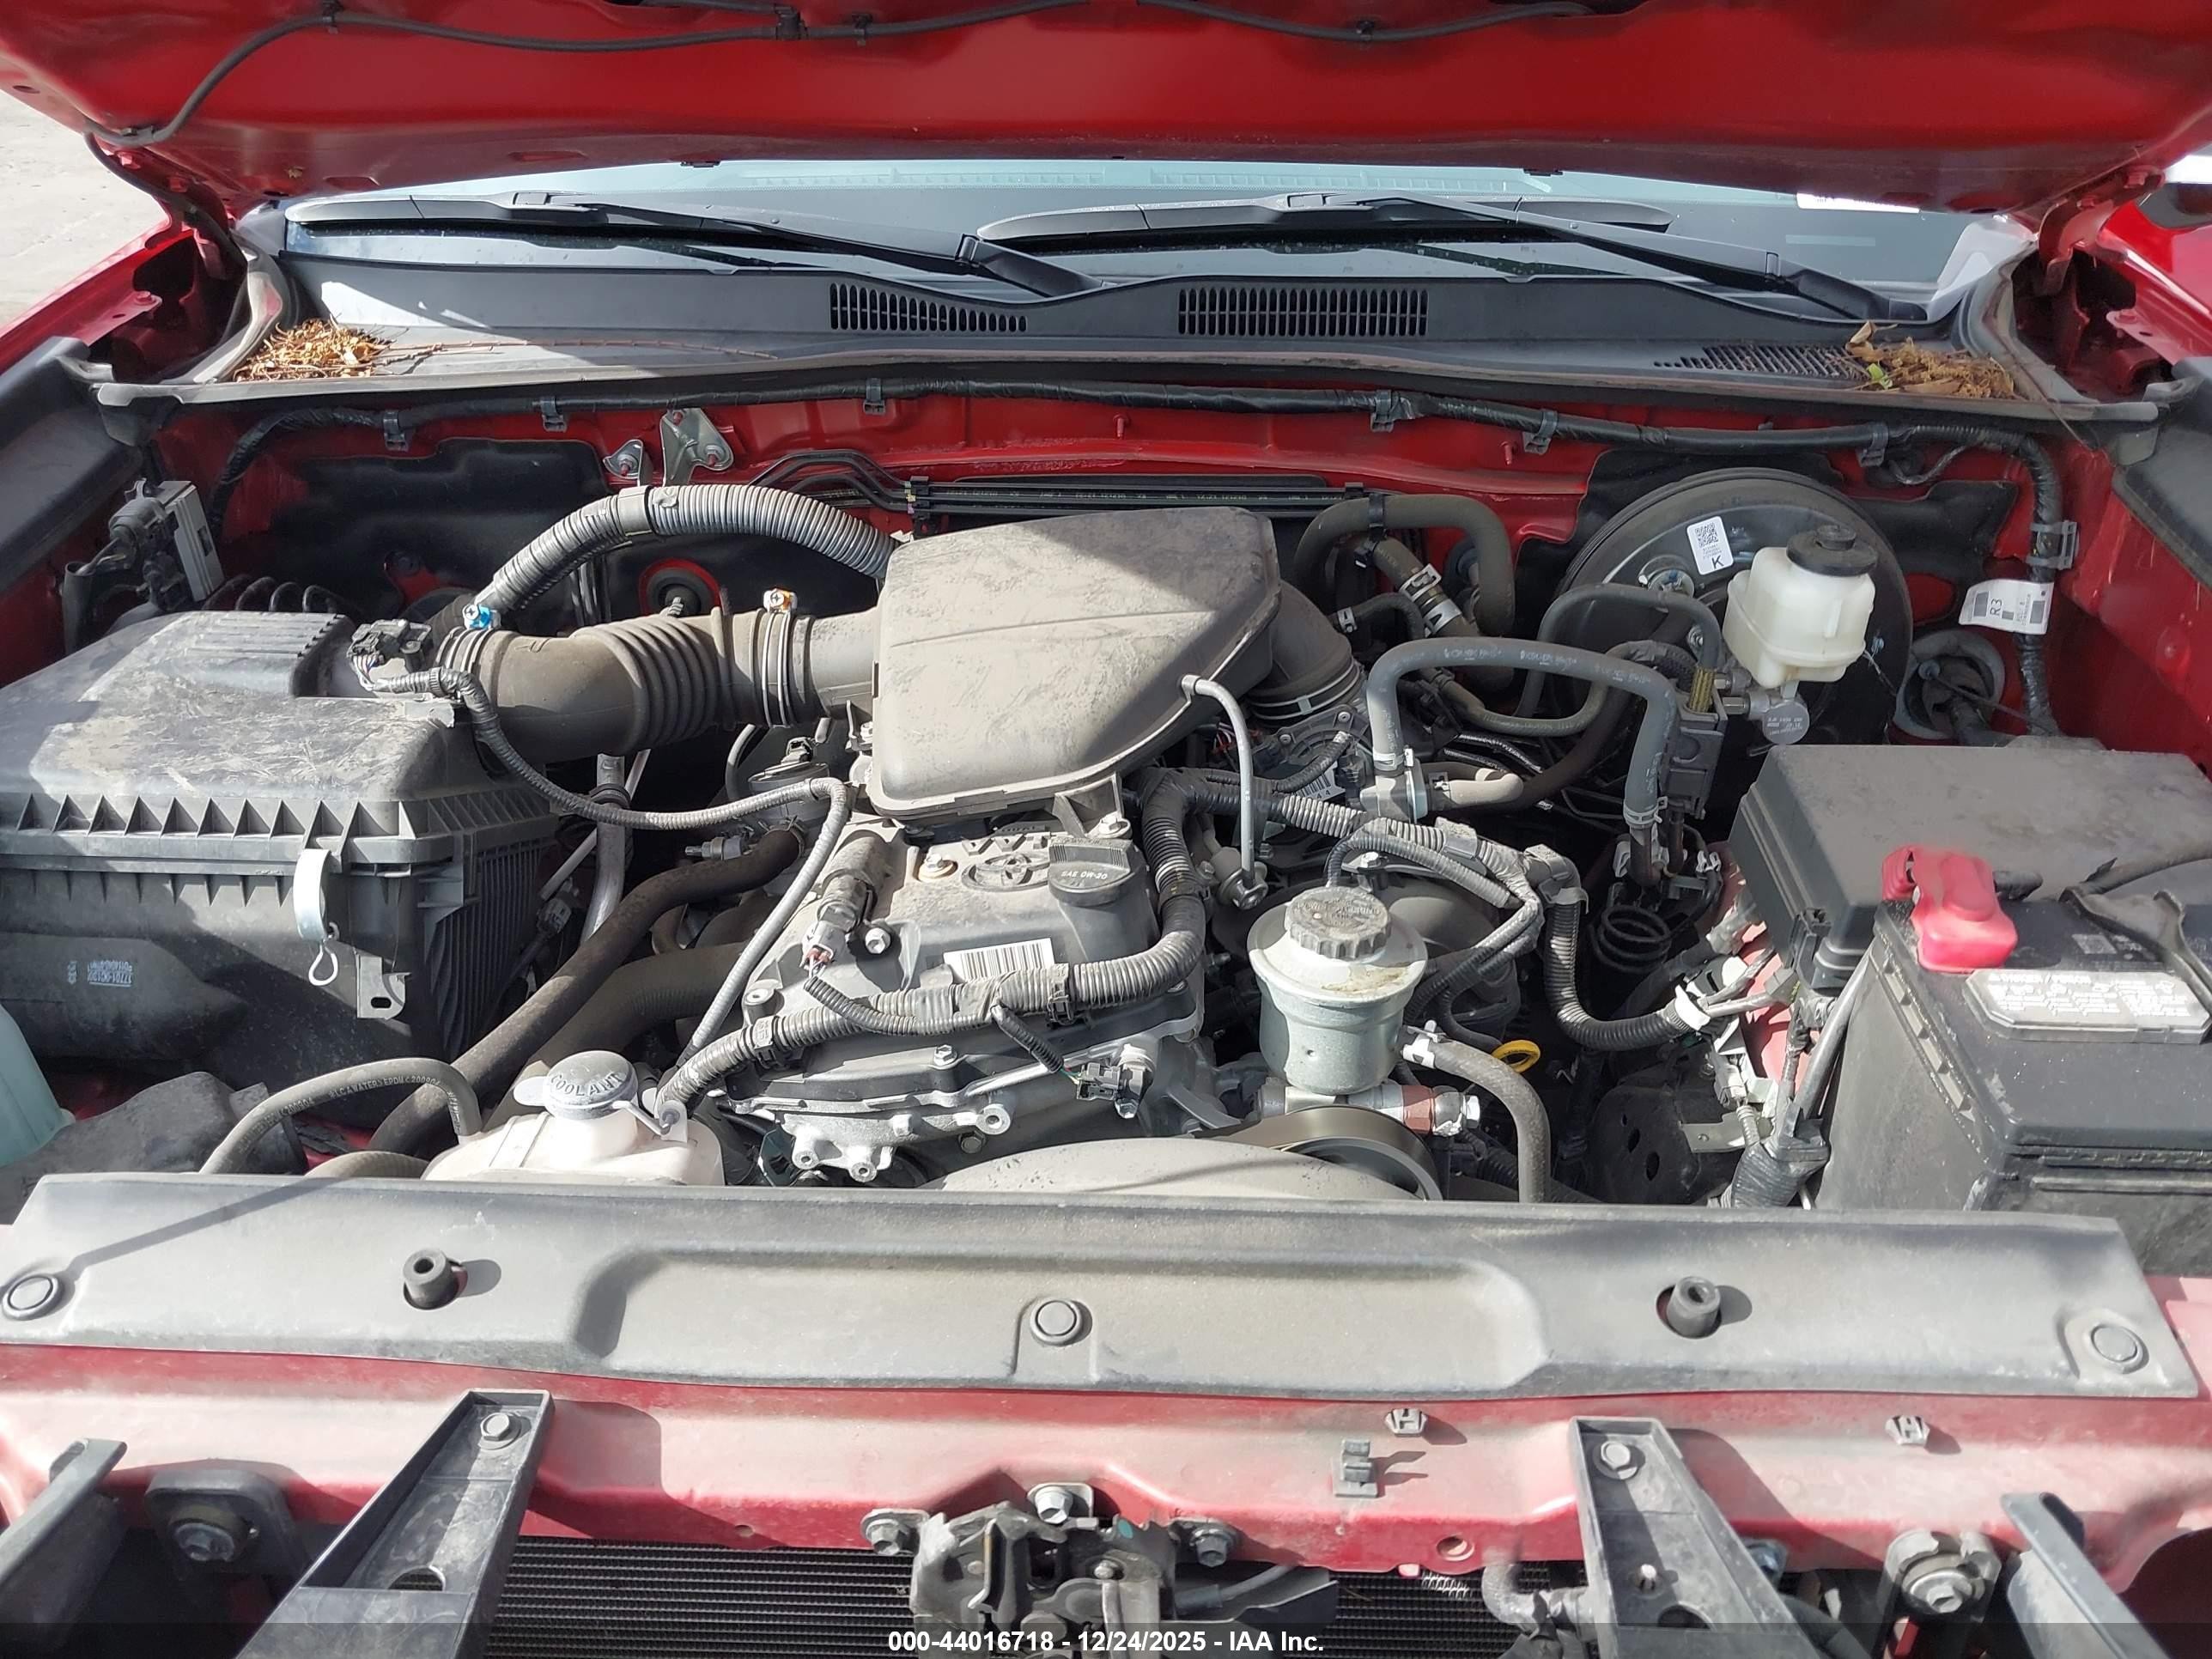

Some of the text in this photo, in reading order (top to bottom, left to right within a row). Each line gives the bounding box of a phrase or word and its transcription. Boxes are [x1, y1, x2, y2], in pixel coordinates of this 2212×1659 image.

[1711, 555, 1724, 569] K
[1990, 598, 2002, 617] R3
[550, 1071, 623, 1097] COOLANT
